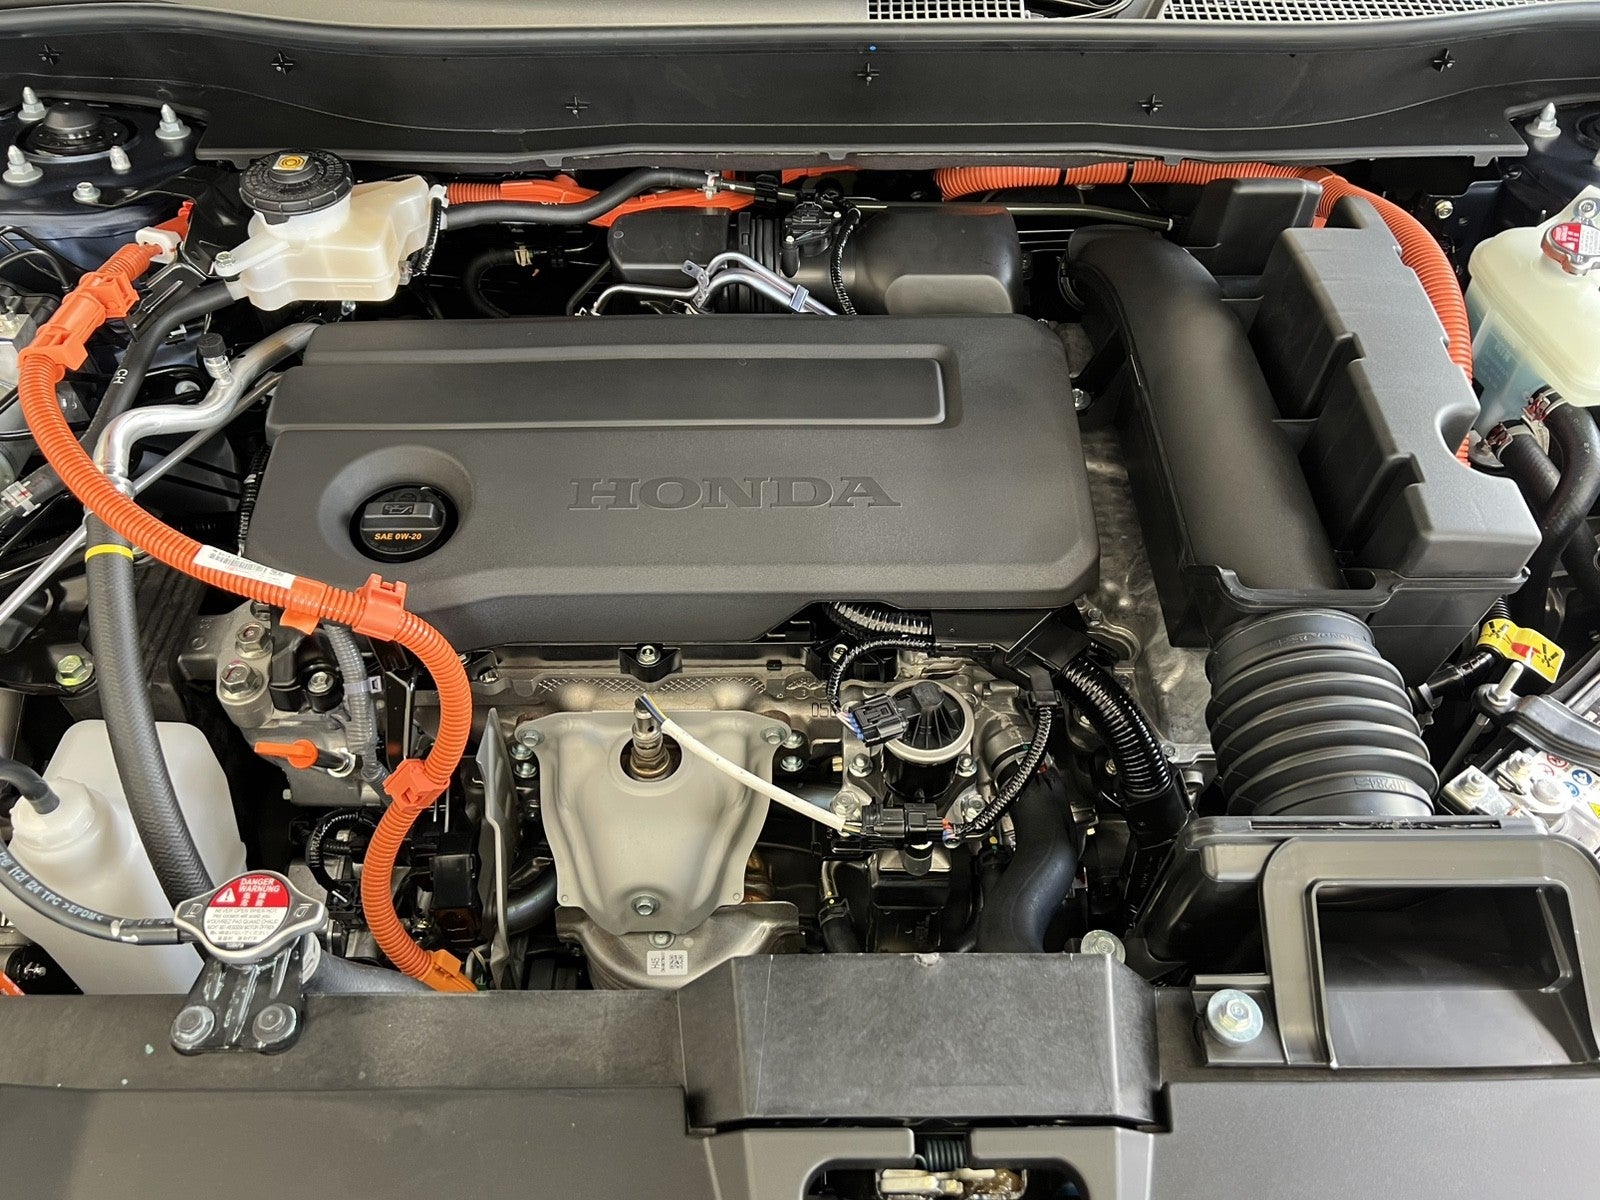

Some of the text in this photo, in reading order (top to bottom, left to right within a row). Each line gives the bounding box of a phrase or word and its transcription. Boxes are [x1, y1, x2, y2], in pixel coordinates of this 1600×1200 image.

[113, 368, 128, 385] CH
[568, 476, 902, 510] HONDA
[374, 532, 422, 540] SAE 0W-20
[238, 884, 281, 893] WARNUNG
